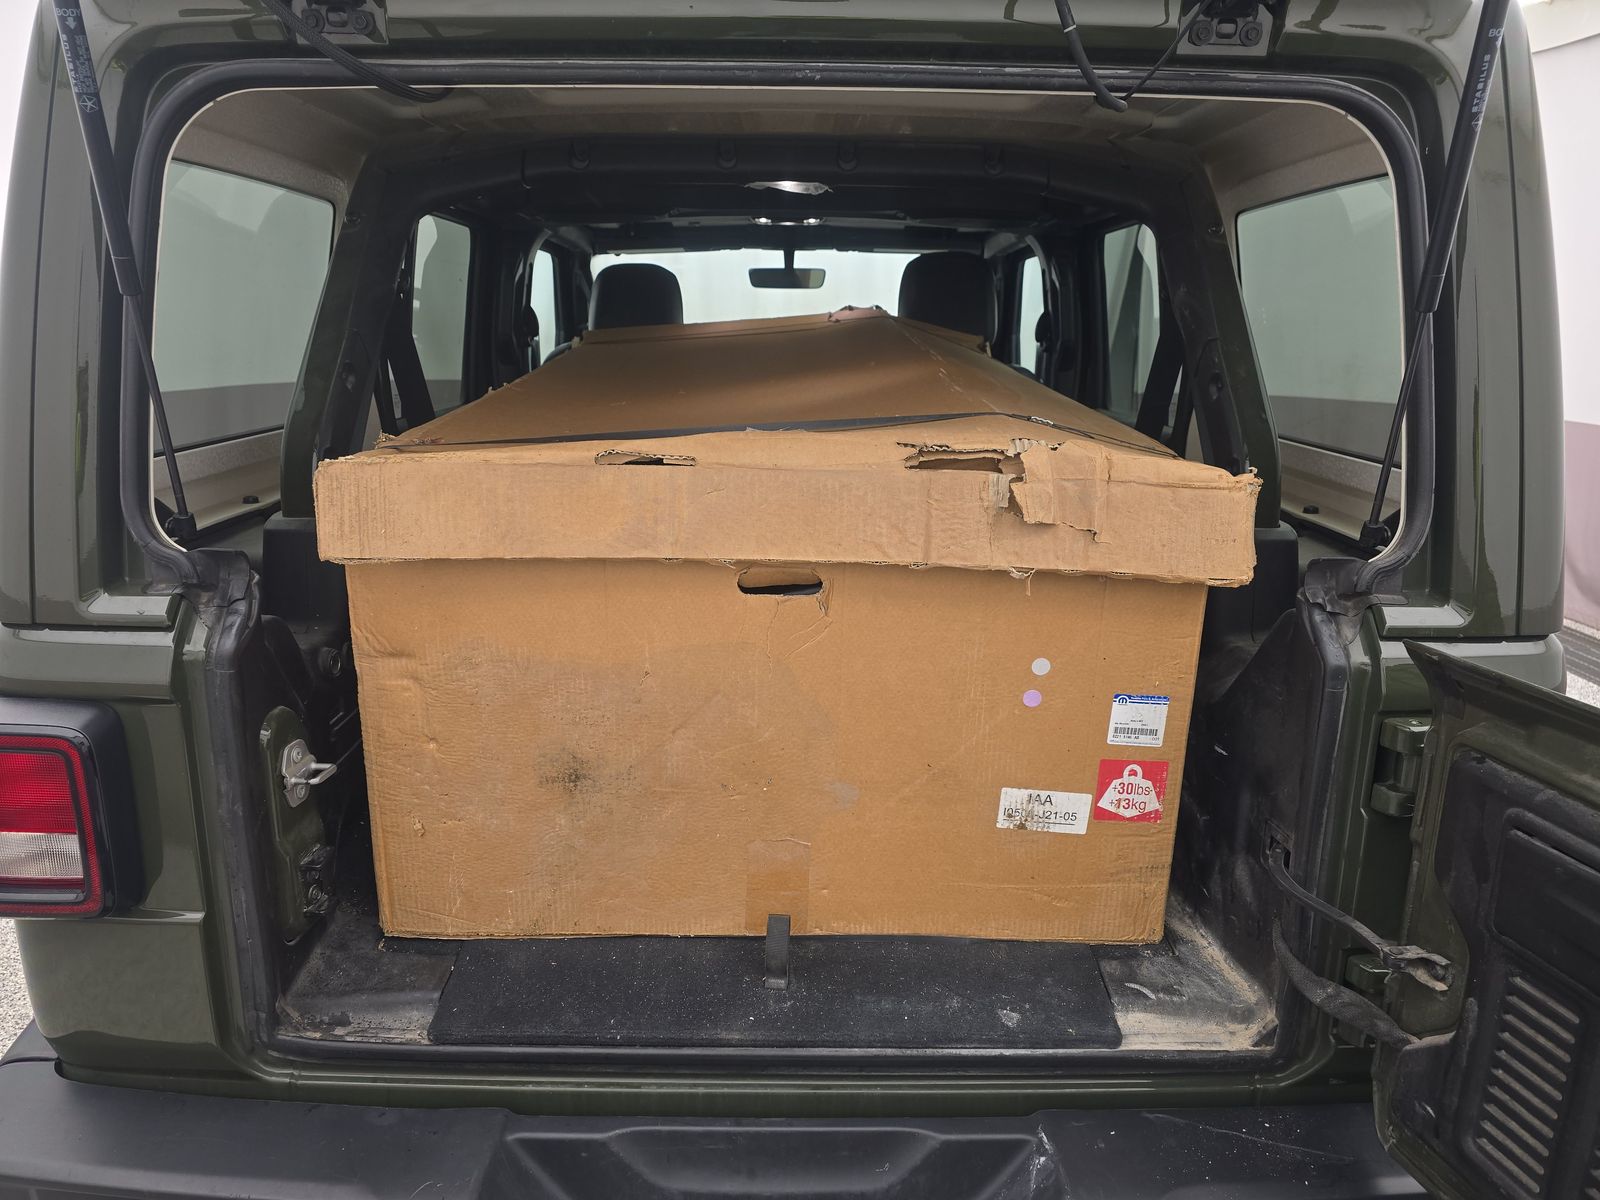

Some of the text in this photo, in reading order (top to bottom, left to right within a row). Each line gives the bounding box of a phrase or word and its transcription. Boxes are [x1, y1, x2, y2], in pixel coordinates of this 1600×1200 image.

[55, 7, 81, 17] BODY
[1472, 54, 1491, 113] STABILUS
[1108, 797, 1147, 813] +13kg
